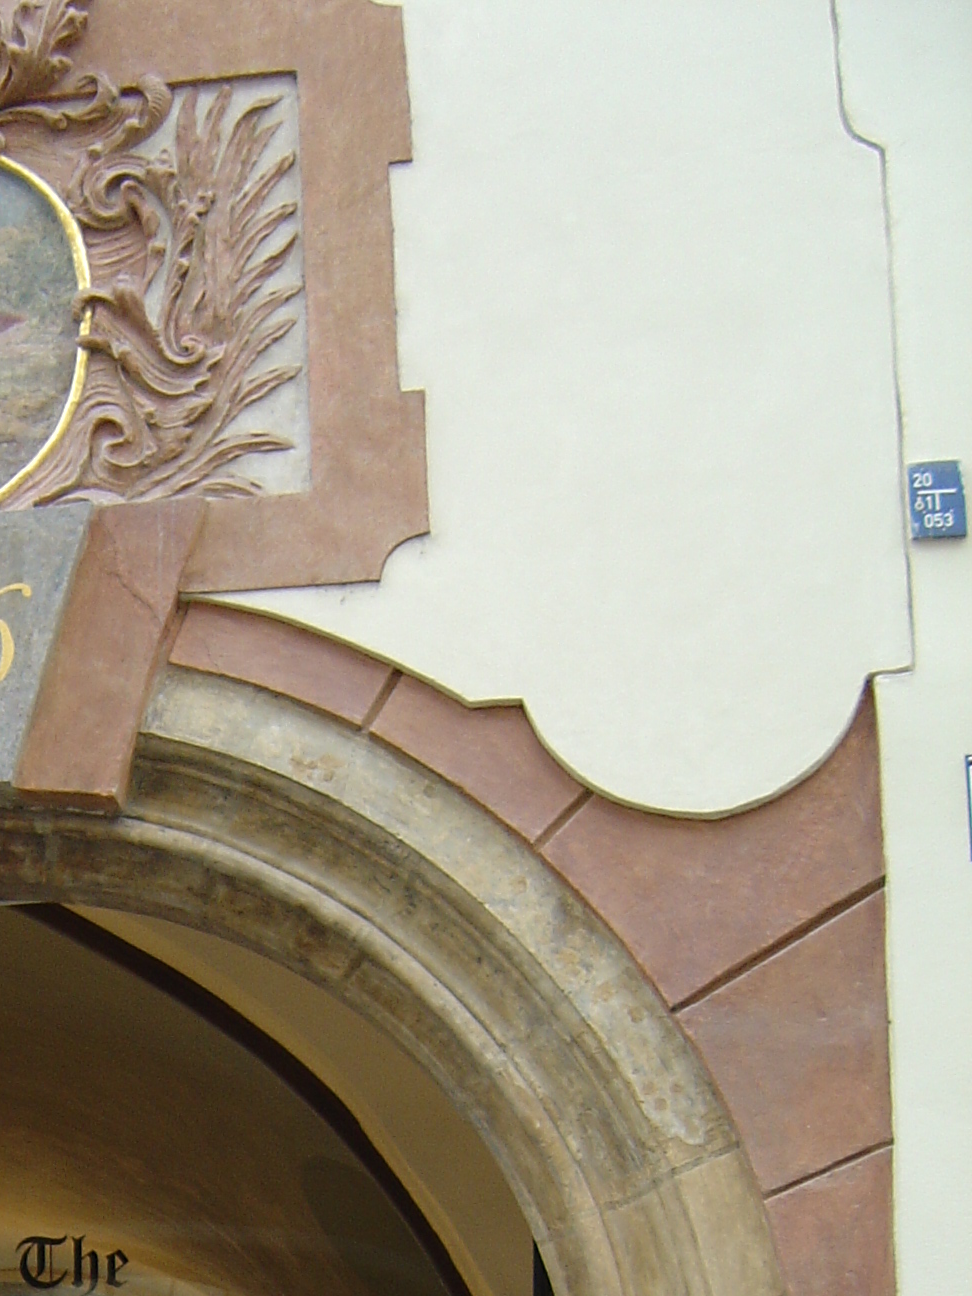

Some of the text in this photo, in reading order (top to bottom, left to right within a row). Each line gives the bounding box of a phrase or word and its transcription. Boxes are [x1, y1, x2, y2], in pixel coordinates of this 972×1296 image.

[912, 472, 933, 488] 20
[924, 512, 955, 529] 053
[15, 1234, 129, 1296] The
